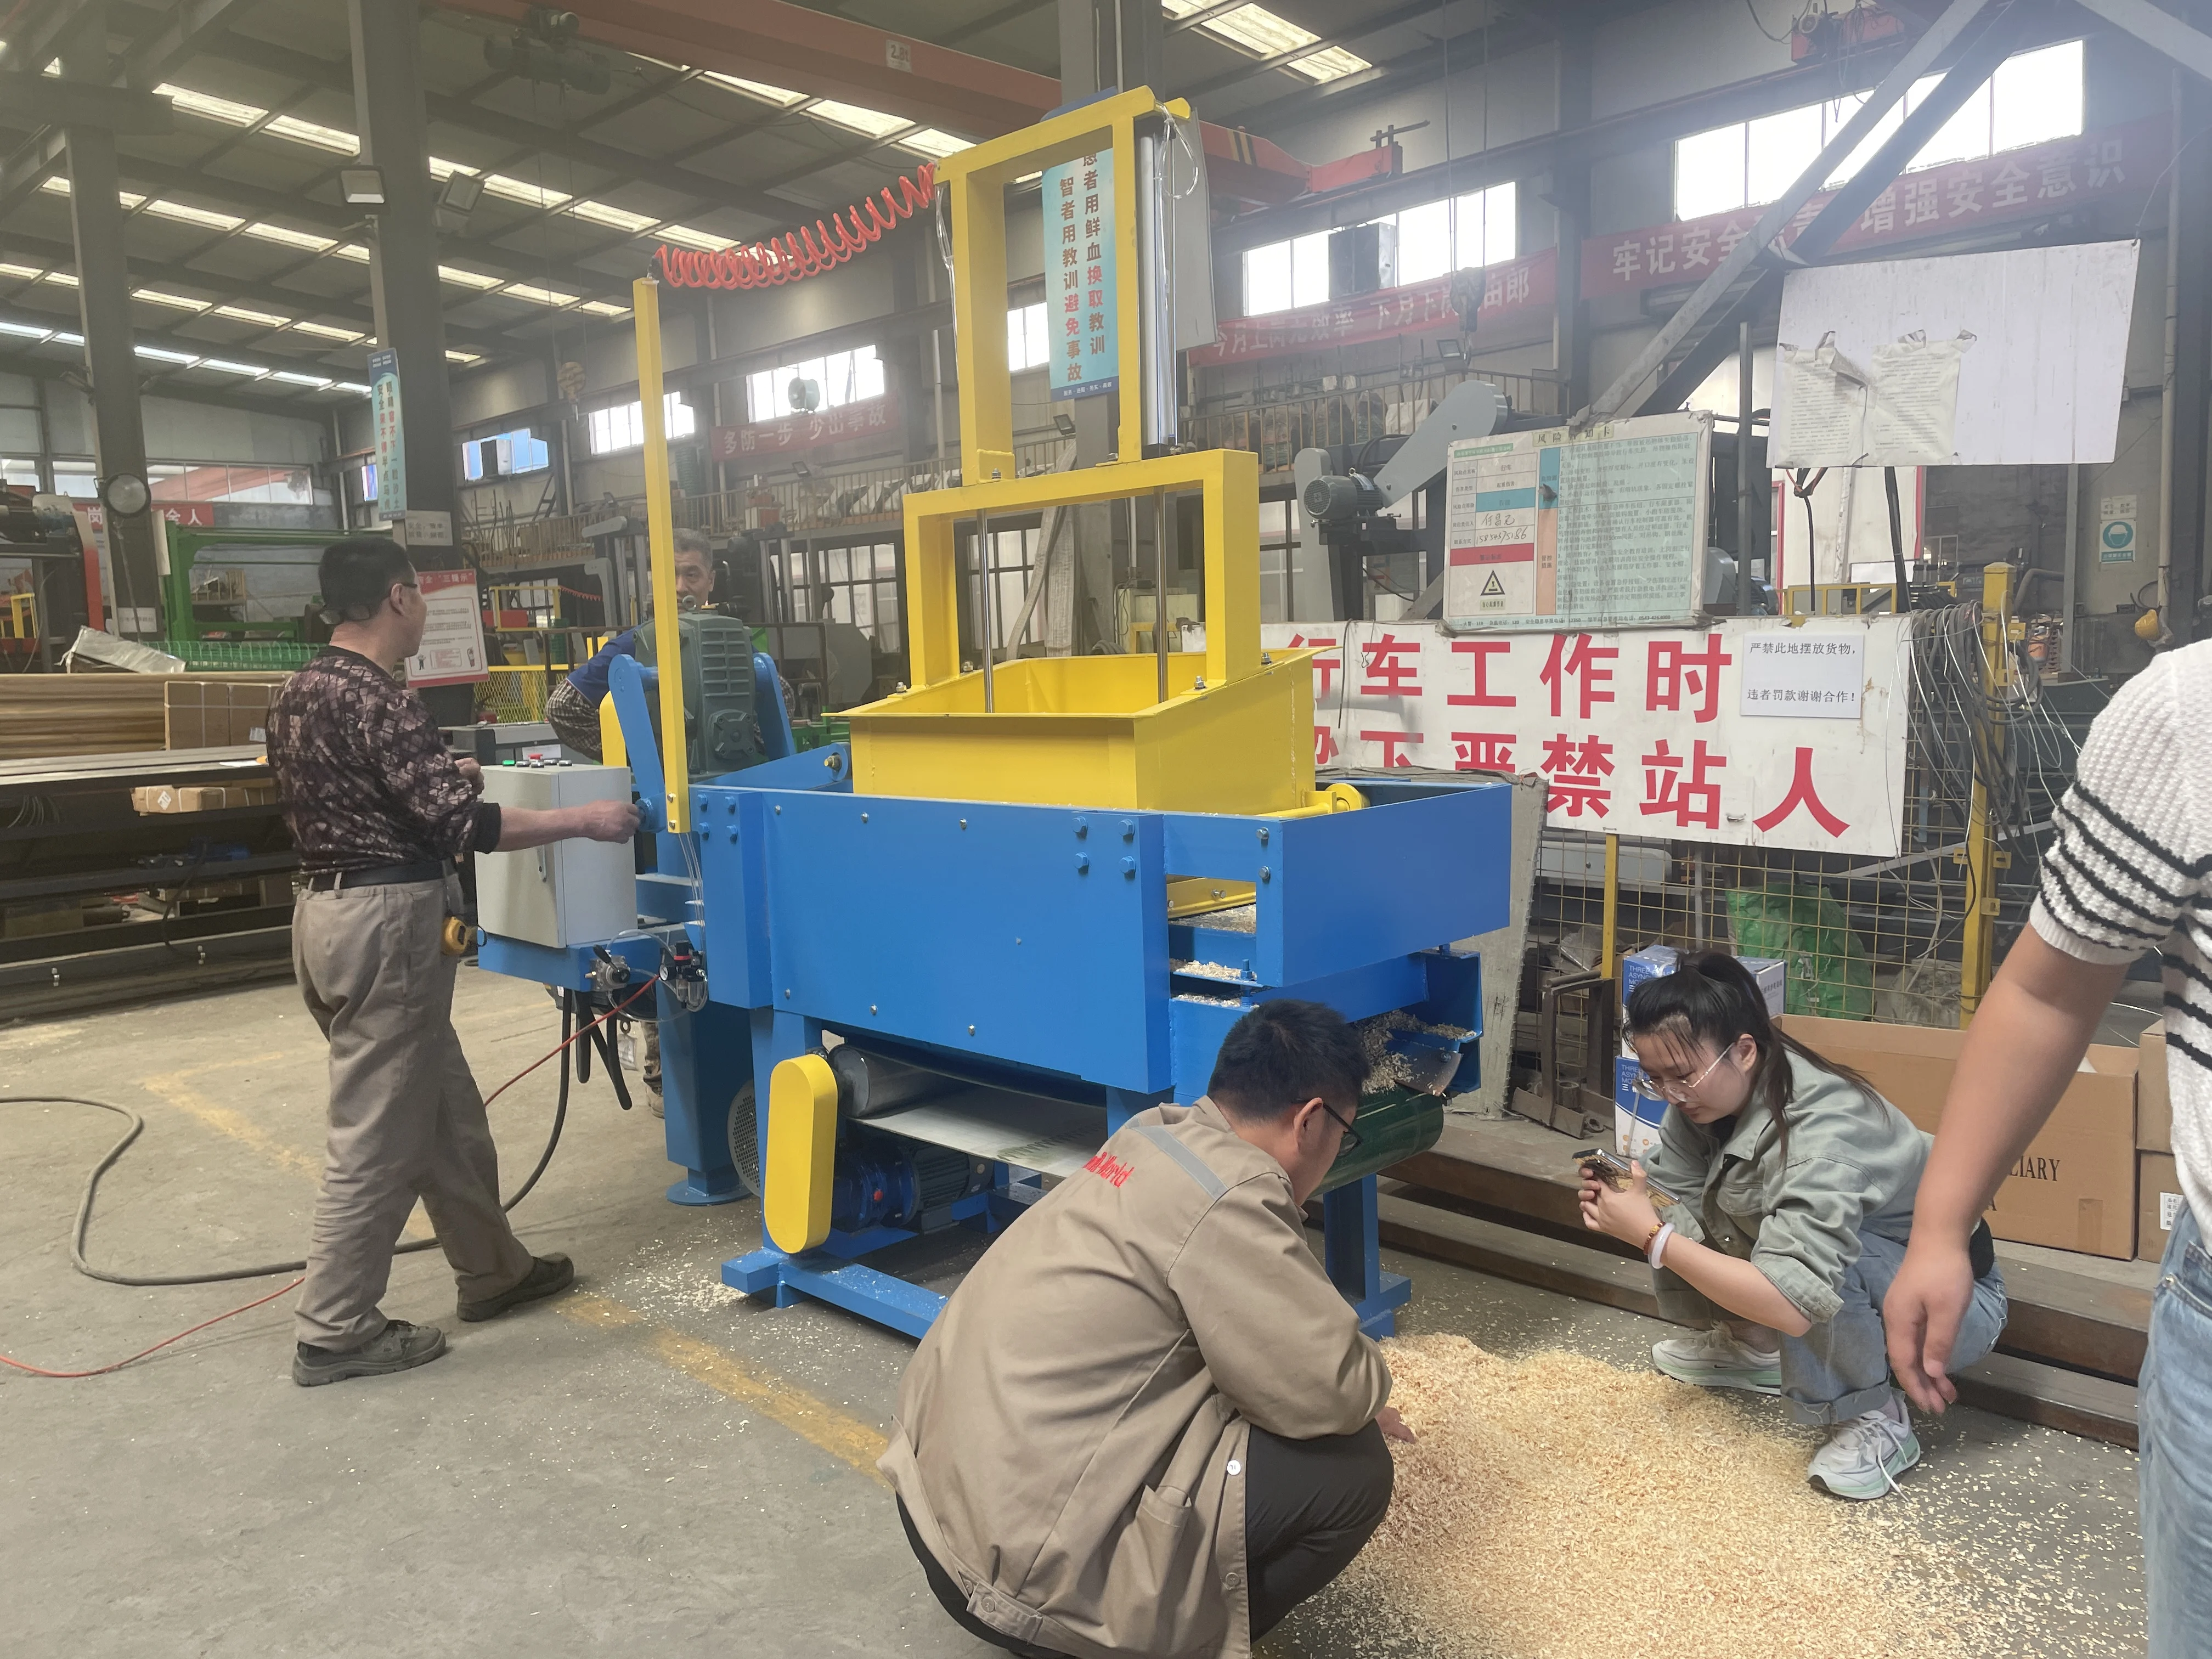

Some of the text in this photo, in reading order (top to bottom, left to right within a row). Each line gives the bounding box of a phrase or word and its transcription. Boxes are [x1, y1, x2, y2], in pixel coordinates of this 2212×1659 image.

[1059, 177, 1082, 382] 智者用教训避免事故
[724, 405, 887, 455] 多防一步 少出事故
[1749, 642, 1856, 655] 严禁此地摆放货物,
